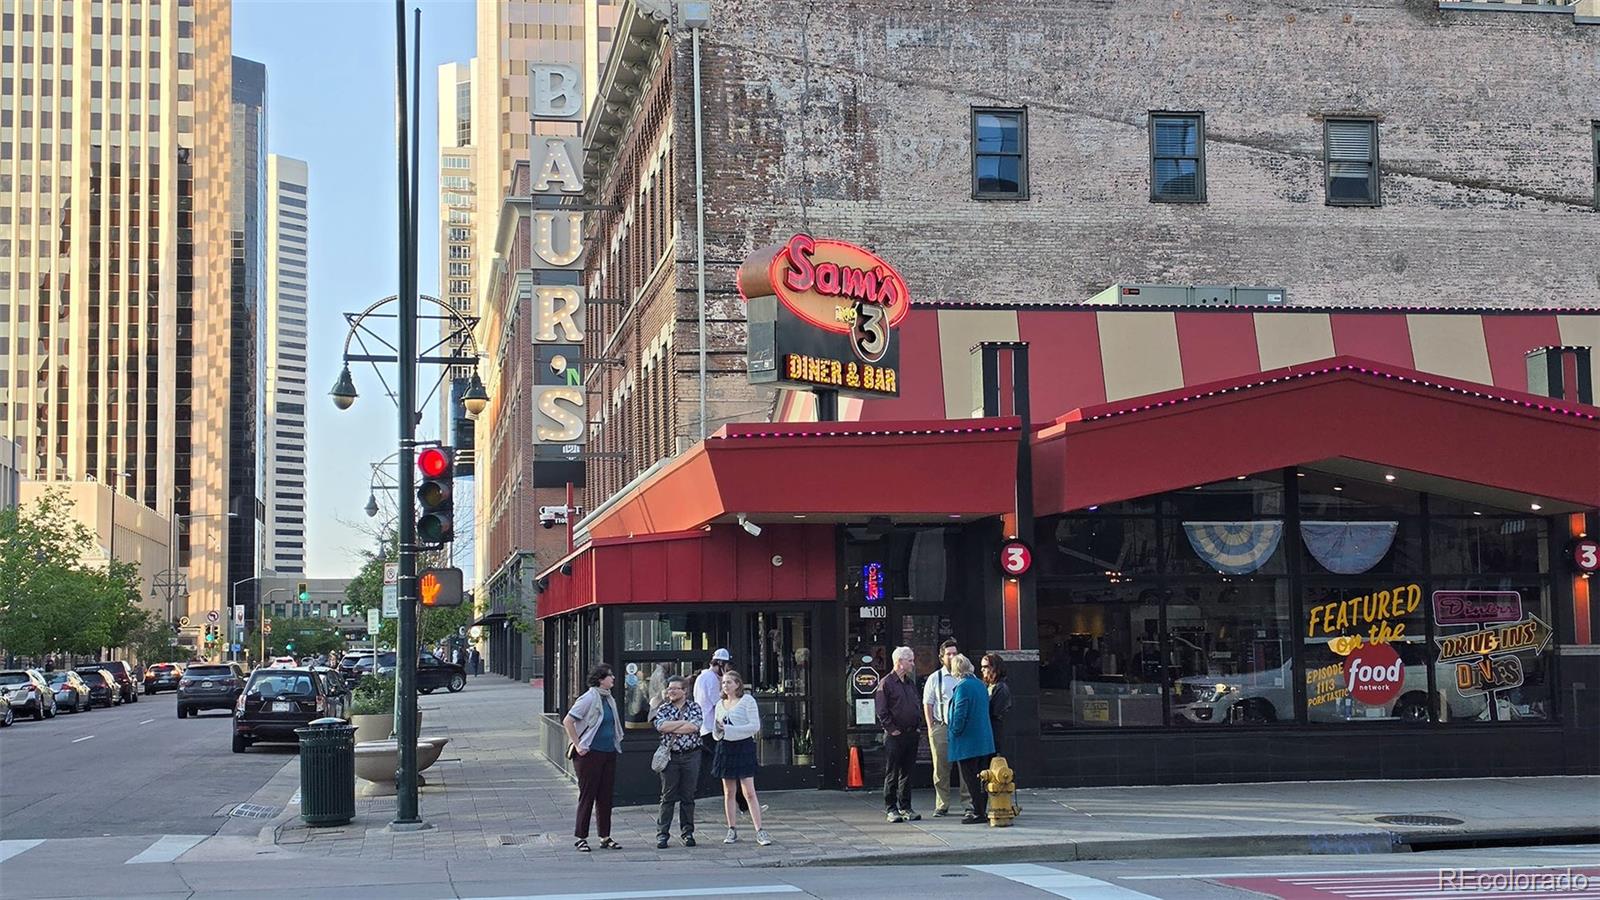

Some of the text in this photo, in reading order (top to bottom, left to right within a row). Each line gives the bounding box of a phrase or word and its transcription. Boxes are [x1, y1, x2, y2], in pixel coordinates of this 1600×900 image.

[784, 234, 898, 307] Sam's
[861, 304, 885, 354] 3
[790, 353, 897, 393] DINER & BAR
[1007, 547, 1025, 571] 3
[1581, 545, 1597, 567] 3
[1309, 584, 1422, 637] FEATURED
[1336, 620, 1406, 653] on the
[1306, 662, 1344, 684] EPISODE
[1348, 658, 1402, 692] food
[1457, 659, 1520, 689] DIVES
[1308, 687, 1349, 707] PORKTASTIC
